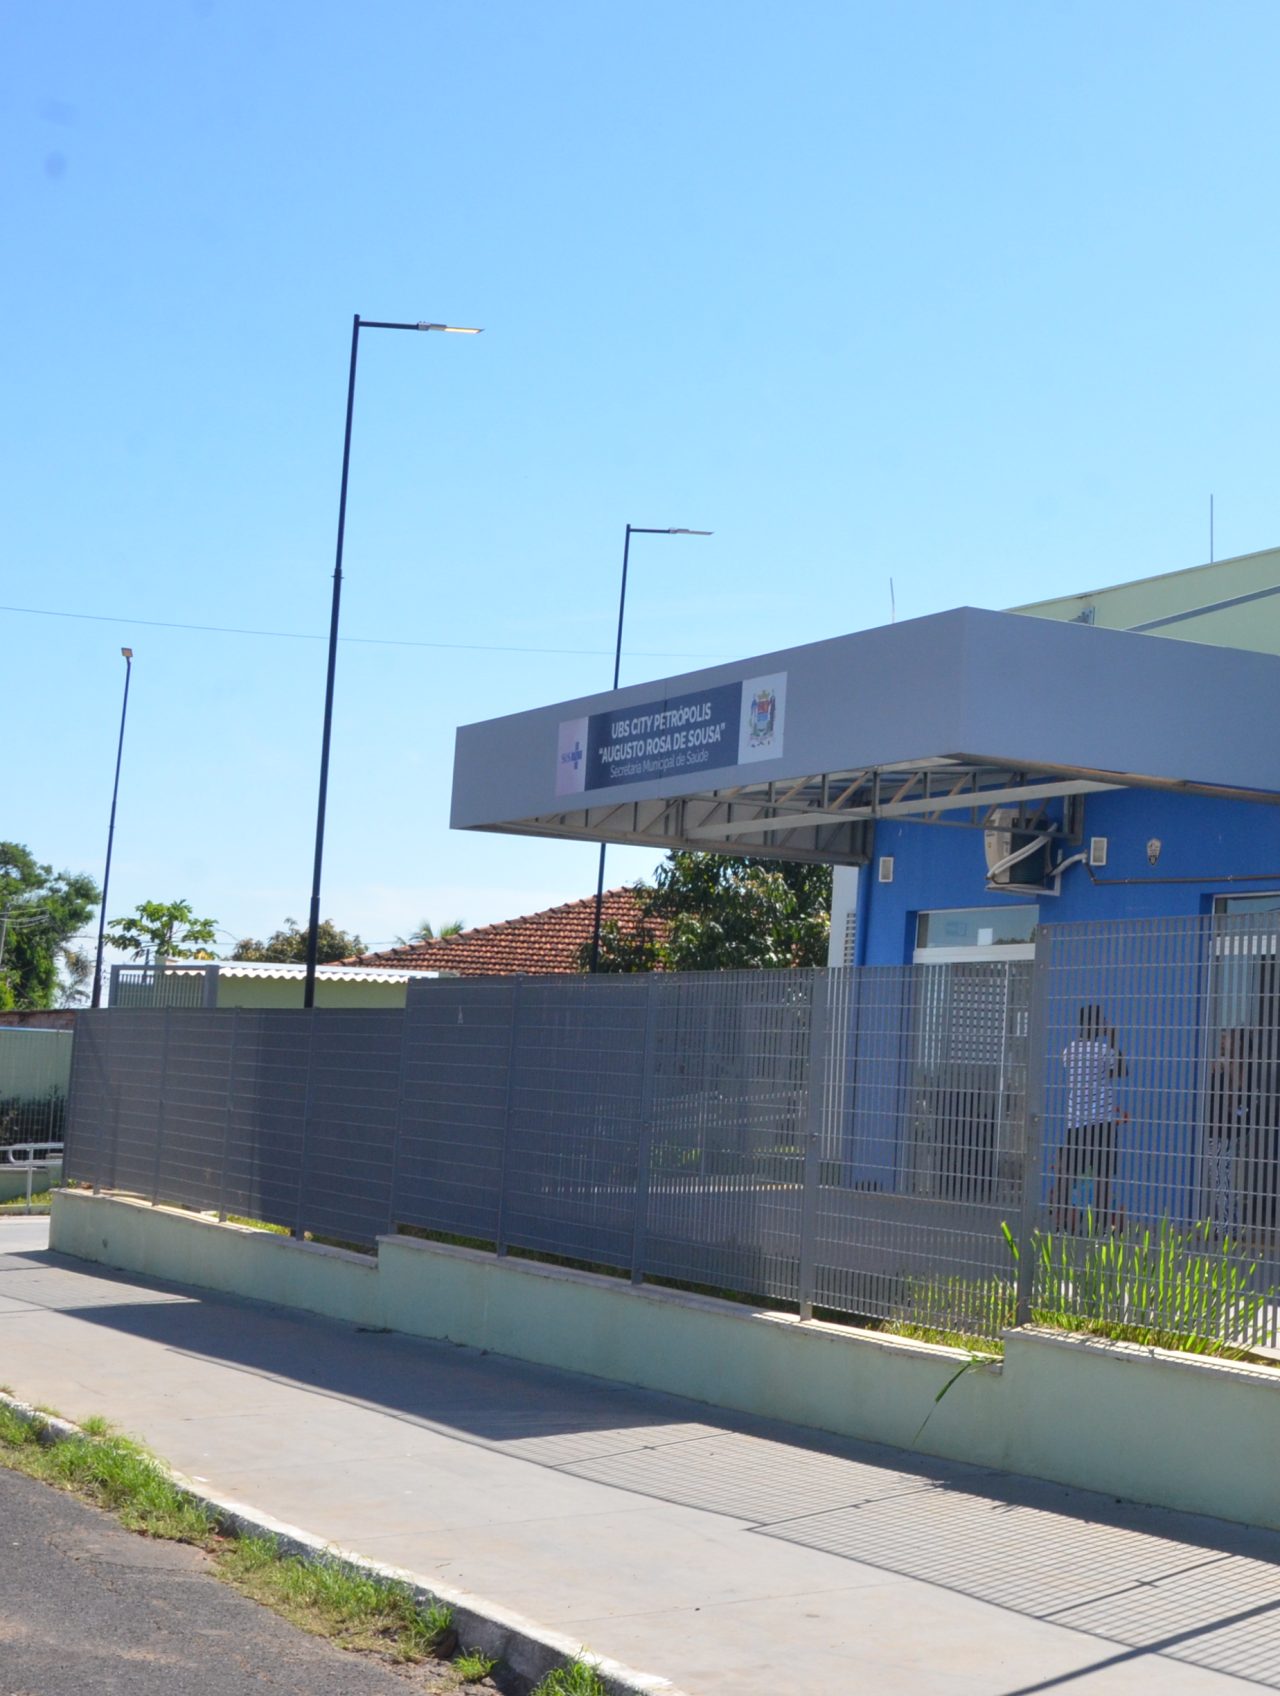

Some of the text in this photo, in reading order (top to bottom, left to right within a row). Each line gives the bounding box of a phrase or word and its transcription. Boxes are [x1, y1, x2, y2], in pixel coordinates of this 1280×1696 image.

[611, 702, 712, 739] UBS CITY PETRÓPOLIS
[646, 734, 672, 755] ROSA
[673, 731, 687, 751] DE
[610, 748, 709, 778] Secretaria Municipal de Saúde
